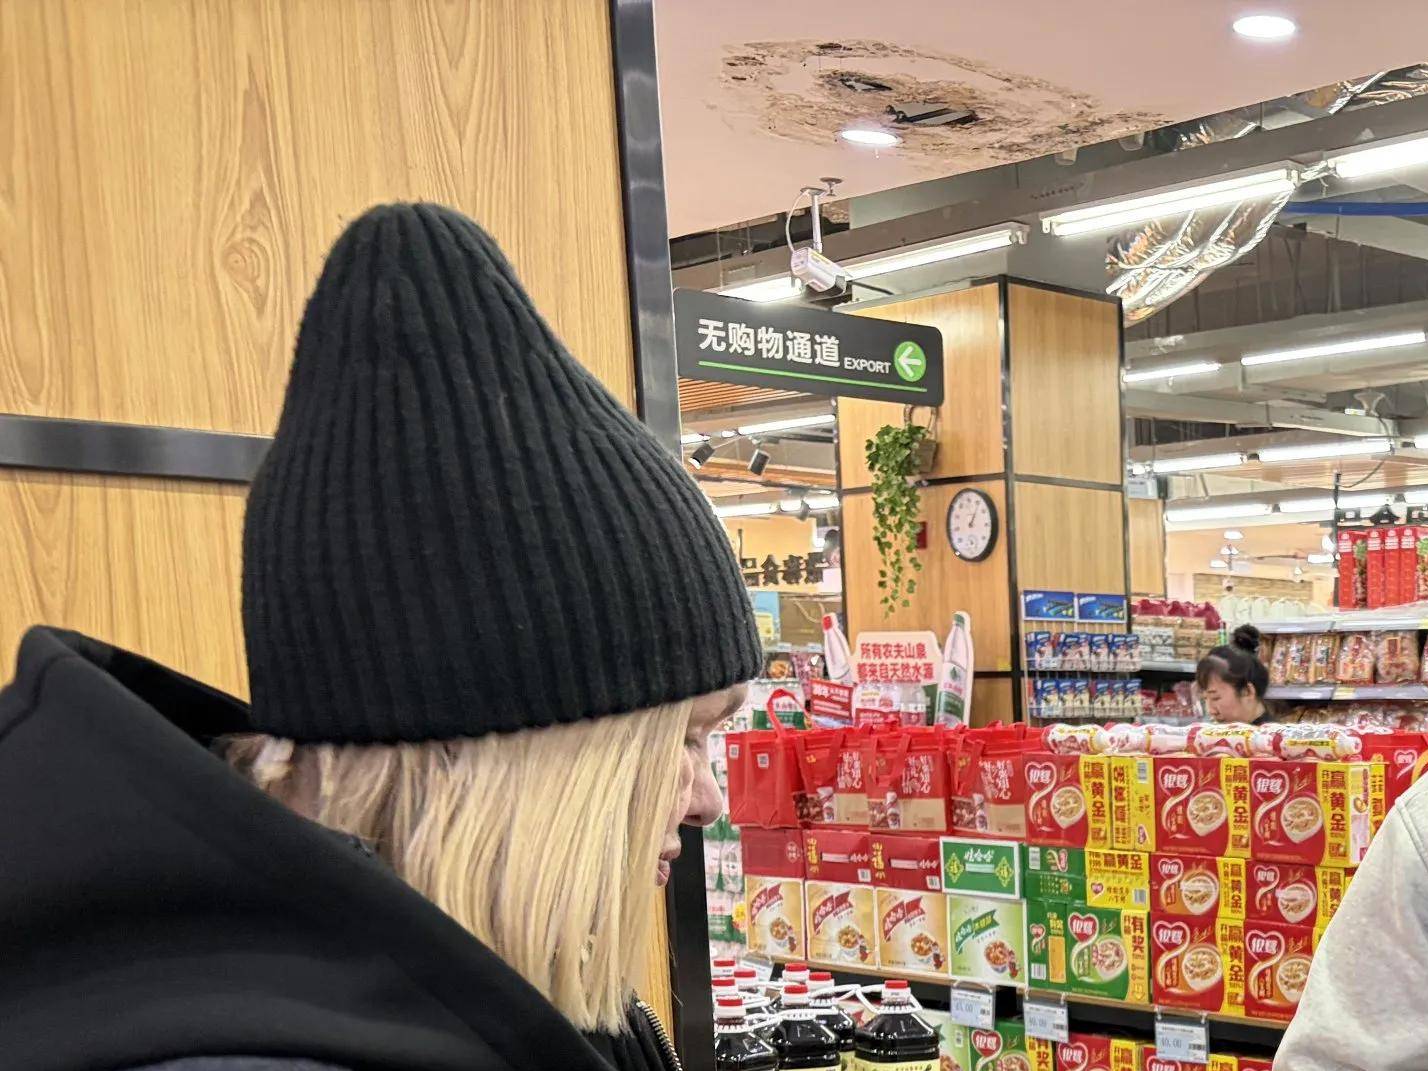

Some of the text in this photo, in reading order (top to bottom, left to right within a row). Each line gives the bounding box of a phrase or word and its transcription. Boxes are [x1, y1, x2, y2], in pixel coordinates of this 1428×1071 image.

[698, 318, 892, 374] 无购物通道 EXPORT
